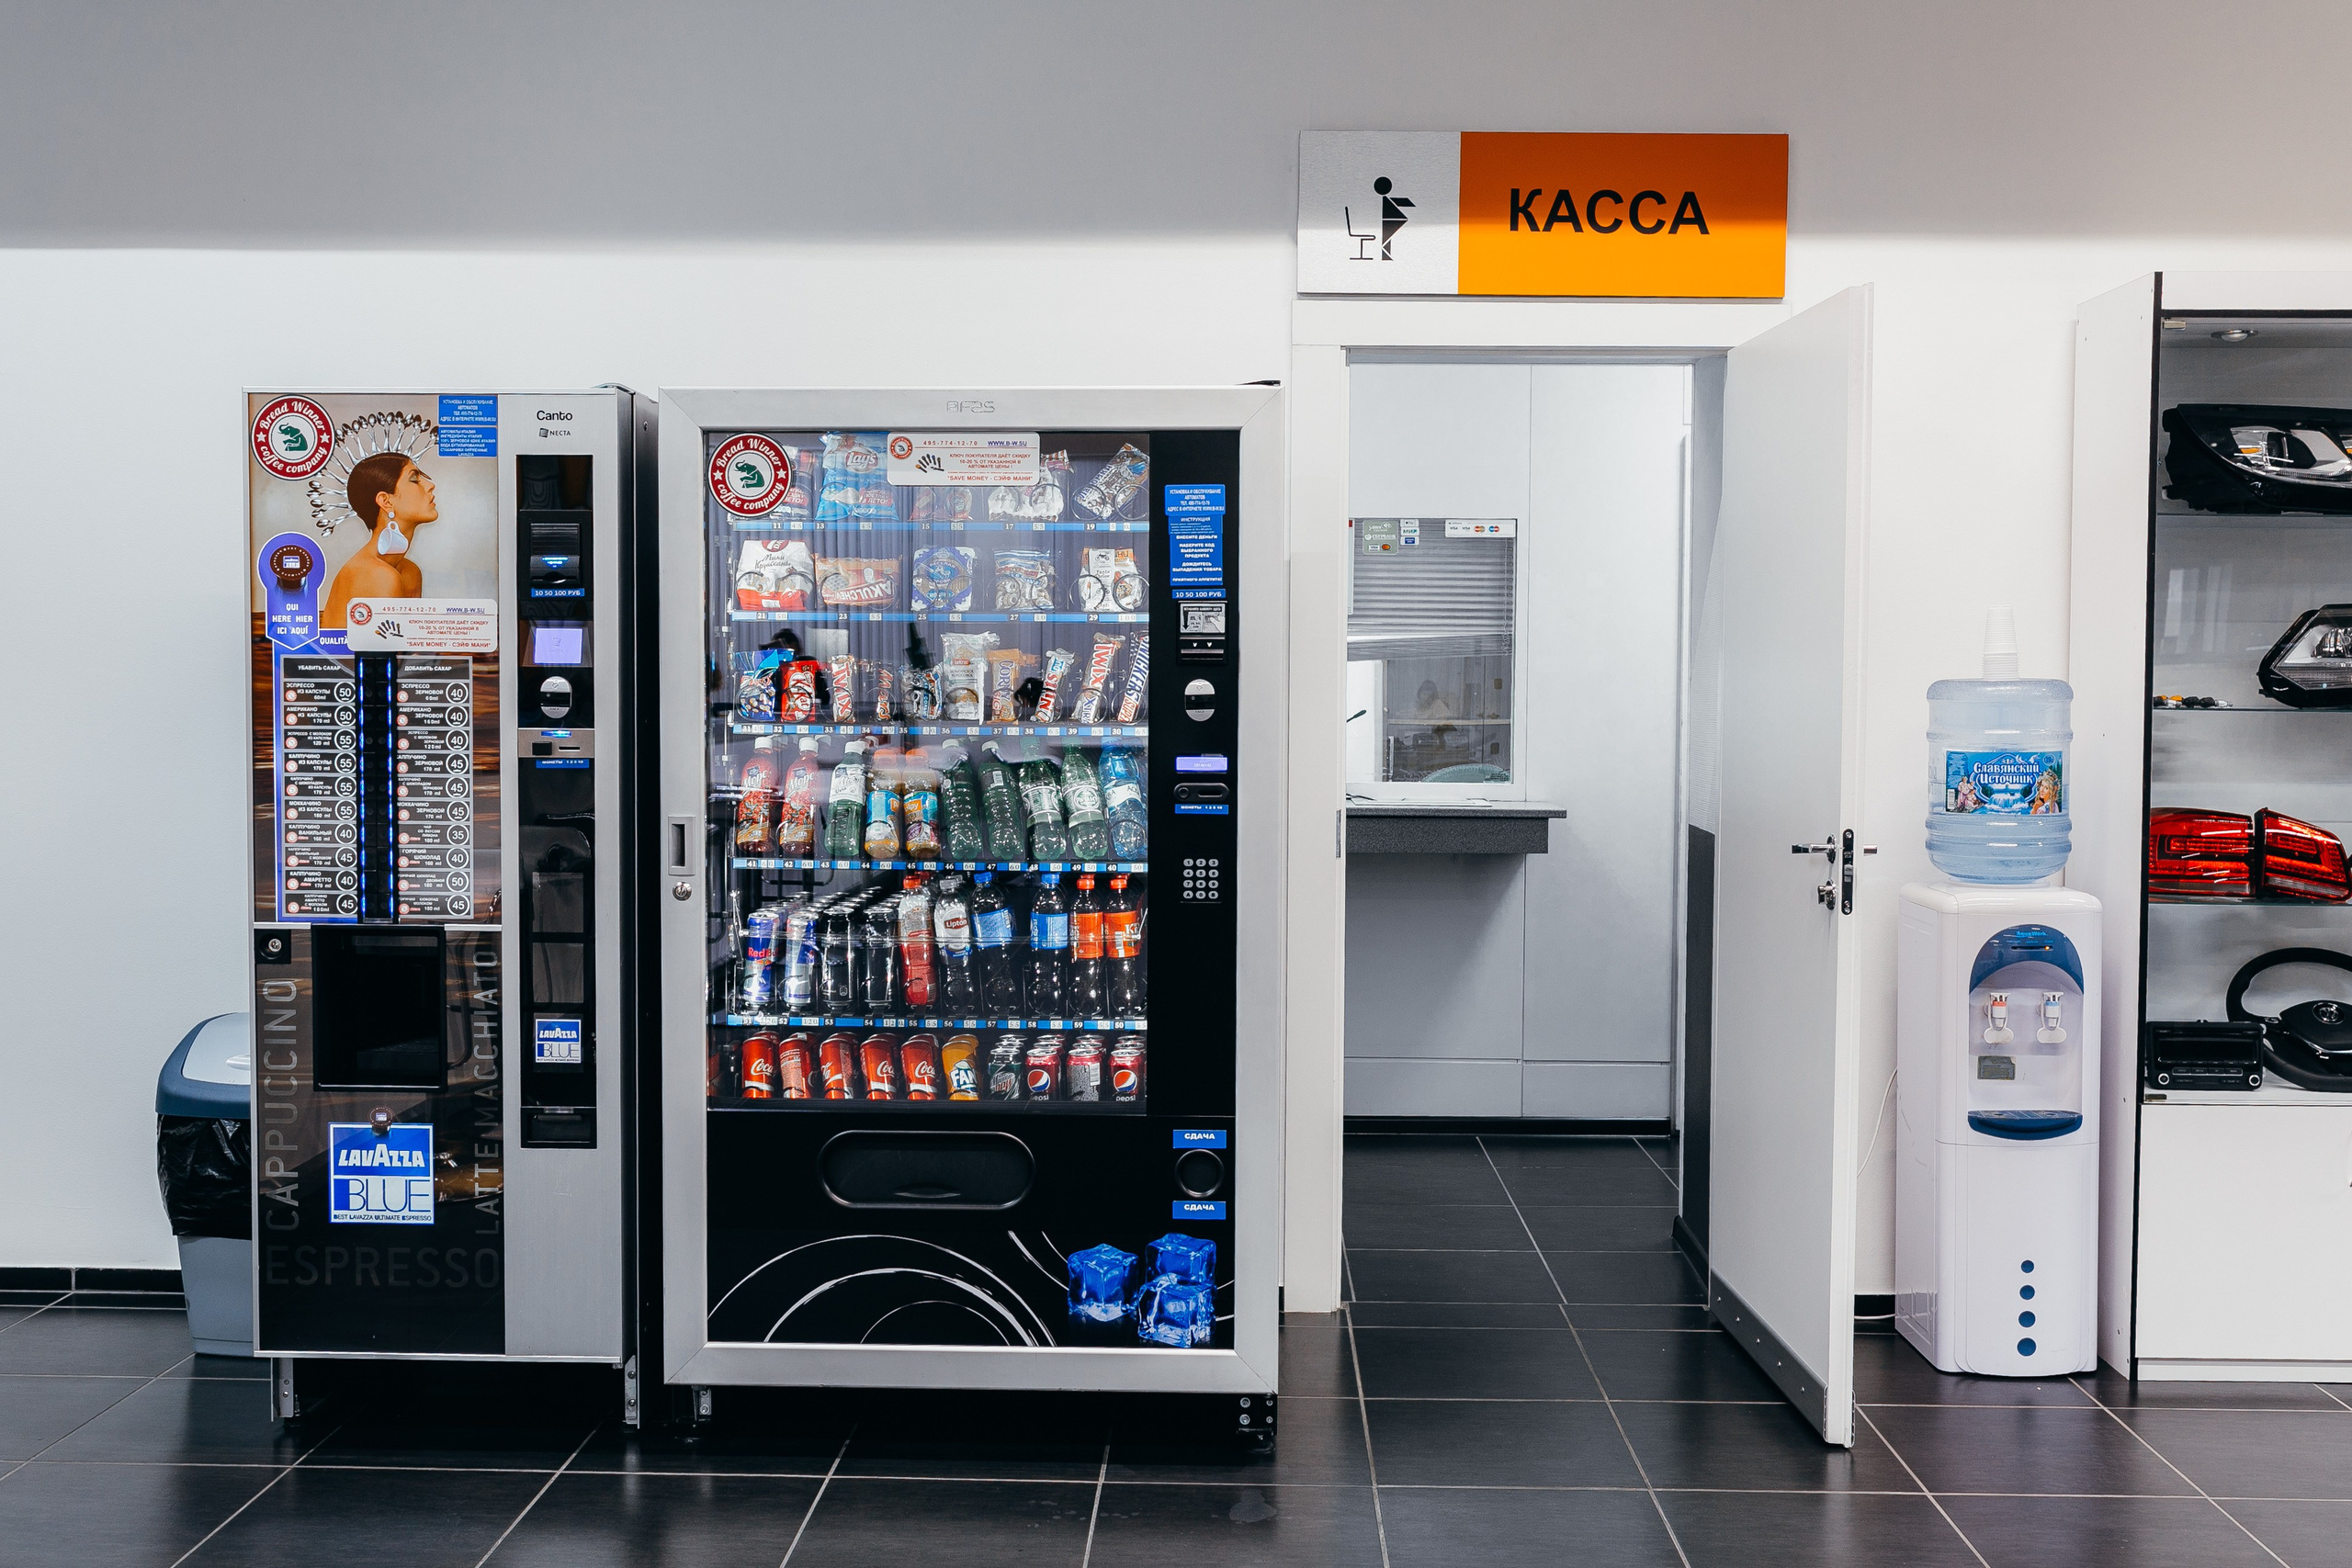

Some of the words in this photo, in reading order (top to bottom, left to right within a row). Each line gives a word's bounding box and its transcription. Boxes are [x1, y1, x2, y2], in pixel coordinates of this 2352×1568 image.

[1510, 187, 1710, 235] КАССА
[260, 402, 288, 430] Bread
[291, 401, 325, 430] Winner
[537, 411, 572, 421] Canto
[717, 440, 744, 468] Bread
[748, 439, 781, 466] Winner
[261, 446, 284, 470] coffee
[286, 446, 327, 472] company
[718, 484, 741, 507] coffee
[743, 482, 785, 510] company
[1090, 643, 1116, 690] TWIX
[339, 688, 352, 697] 50
[451, 689, 463, 697] 40
[878, 669, 893, 720] Mars
[340, 712, 352, 720] 50
[450, 713, 463, 721] 40
[340, 736, 352, 744] 55
[451, 736, 463, 745] 40
[340, 759, 352, 768] 55
[451, 760, 463, 768] 45
[1973, 762, 2040, 773] Славянский
[1980, 773, 2034, 784] Источник
[340, 783, 352, 792] 55
[450, 784, 463, 792] 45
[340, 807, 353, 815] 55
[452, 807, 465, 816] 45
[340, 829, 352, 839] 40
[452, 831, 464, 840] 35
[340, 853, 353, 863] 45
[451, 854, 464, 863] 40
[340, 876, 354, 886] 40
[451, 877, 464, 886] 50
[342, 900, 354, 908] 45
[452, 901, 465, 909] 45
[946, 919, 967, 928] Lipton
[748, 947, 765, 958] Red
[539, 1028, 577, 1038] LAVAZZA
[473, 952, 499, 1126] MACCHIATO
[537, 1043, 580, 1058] BLUE
[1116, 1094, 1136, 1102] pepsi
[263, 977, 299, 1231] CAPPUCCINO
[338, 1144, 425, 1168] LAVAZZA
[474, 1144, 499, 1235] LATTE
[334, 1179, 431, 1213] BLUE
[266, 1246, 499, 1286] ESPRESSO
